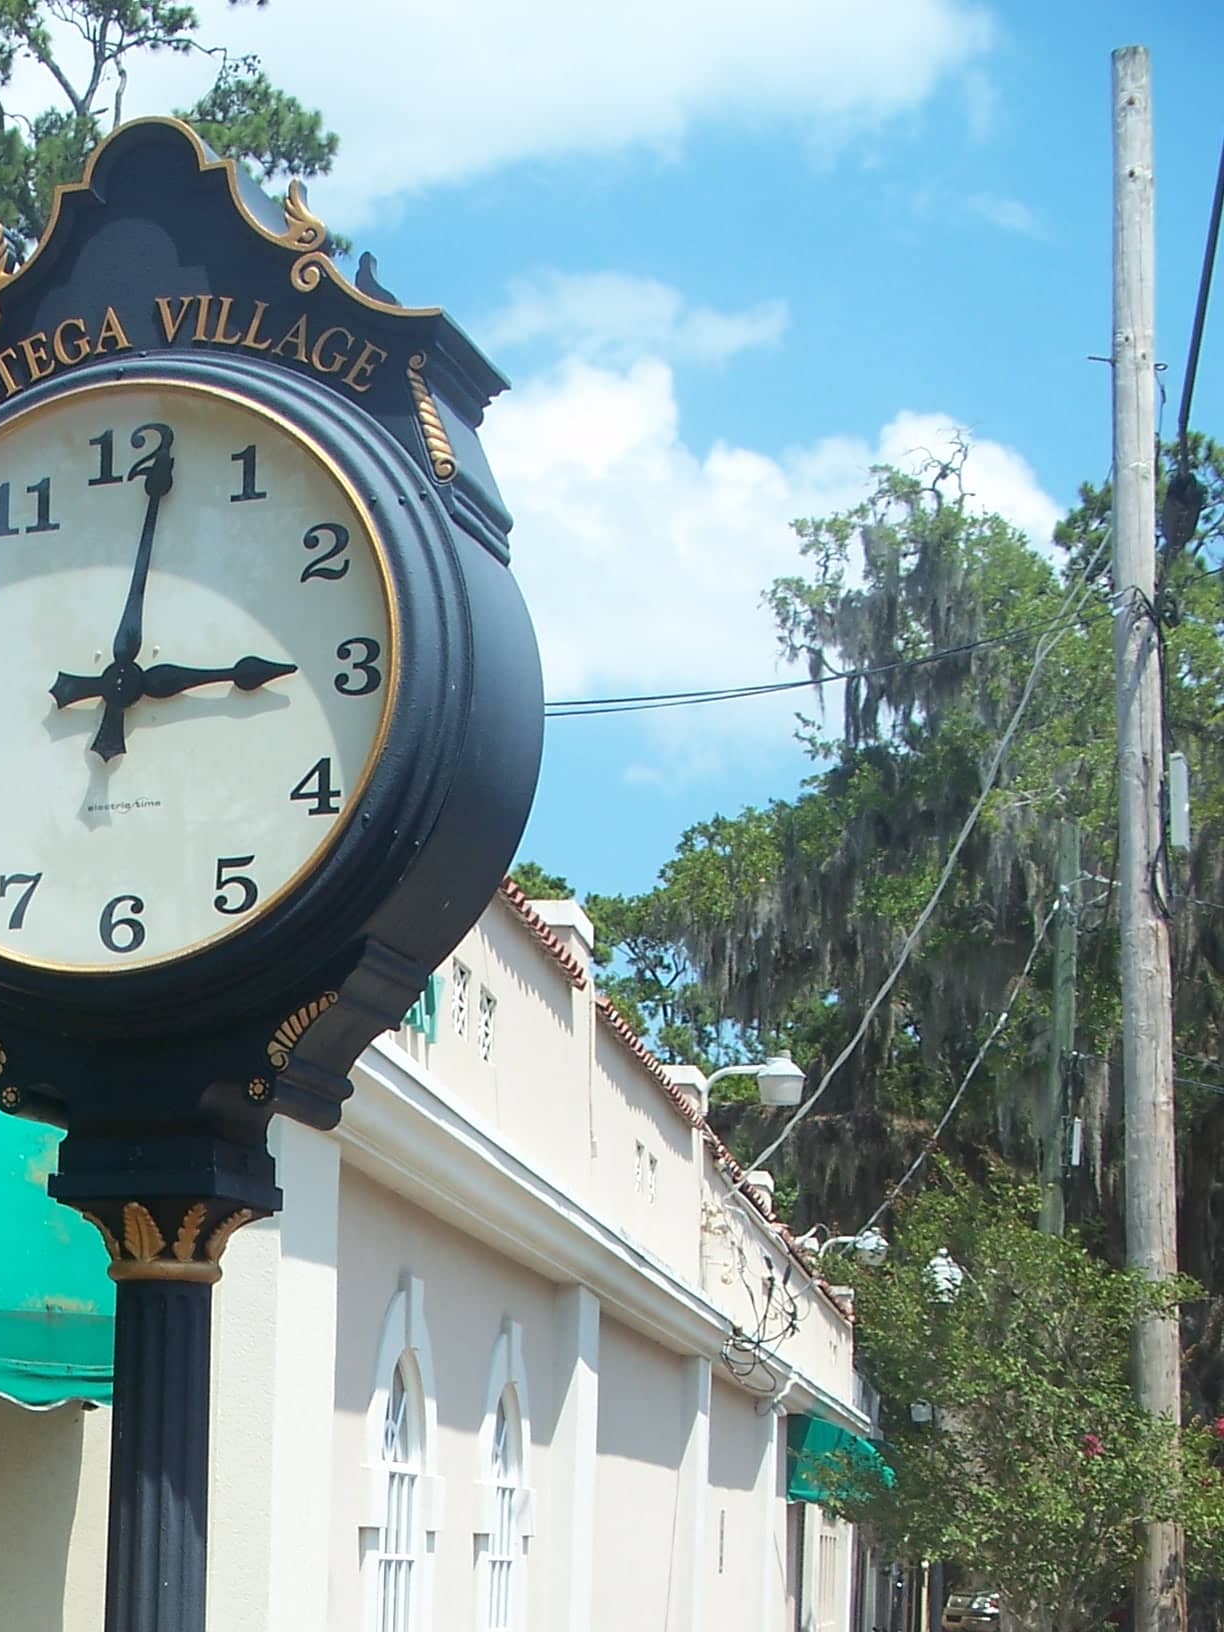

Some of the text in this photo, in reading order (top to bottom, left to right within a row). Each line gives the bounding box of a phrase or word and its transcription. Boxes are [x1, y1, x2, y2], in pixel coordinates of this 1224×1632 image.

[155, 295, 388, 392] VILLAGE
[87, 423, 174, 487] 12
[229, 444, 268, 503] 1
[300, 522, 350, 582] 2
[334, 637, 382, 696] 3
[290, 757, 342, 816] 4
[0, 872, 43, 930] 7
[213, 855, 258, 914] 5
[99, 895, 147, 952] 6
